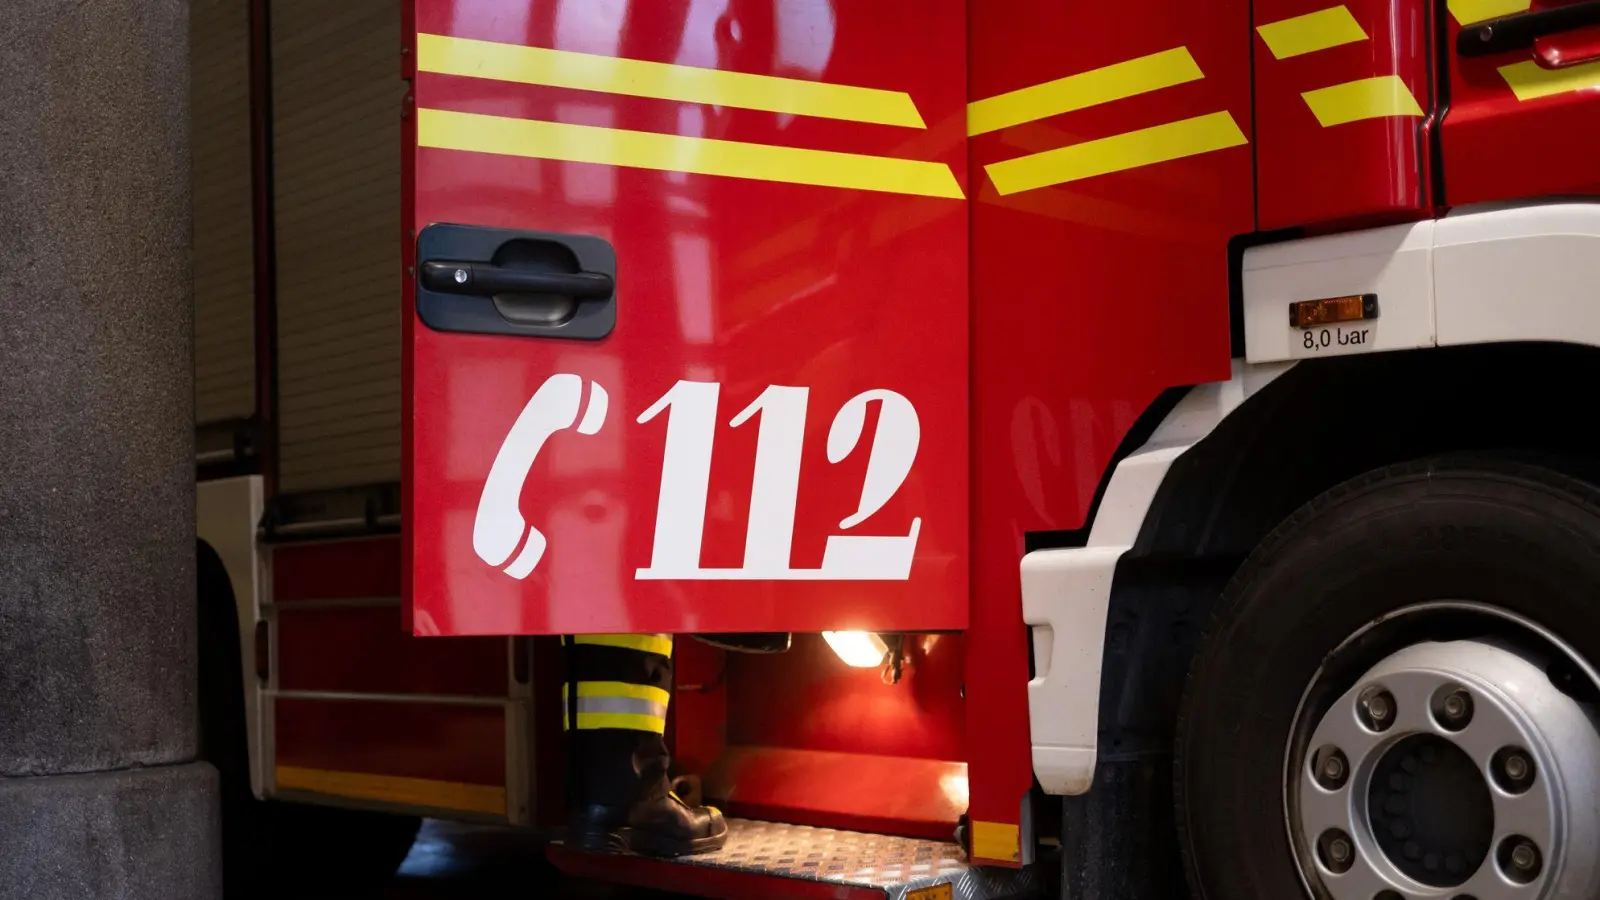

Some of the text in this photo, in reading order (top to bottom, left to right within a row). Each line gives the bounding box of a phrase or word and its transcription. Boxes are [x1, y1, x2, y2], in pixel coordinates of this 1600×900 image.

[1303, 328, 1369, 351] 8,0 bar
[634, 379, 922, 580] 112
